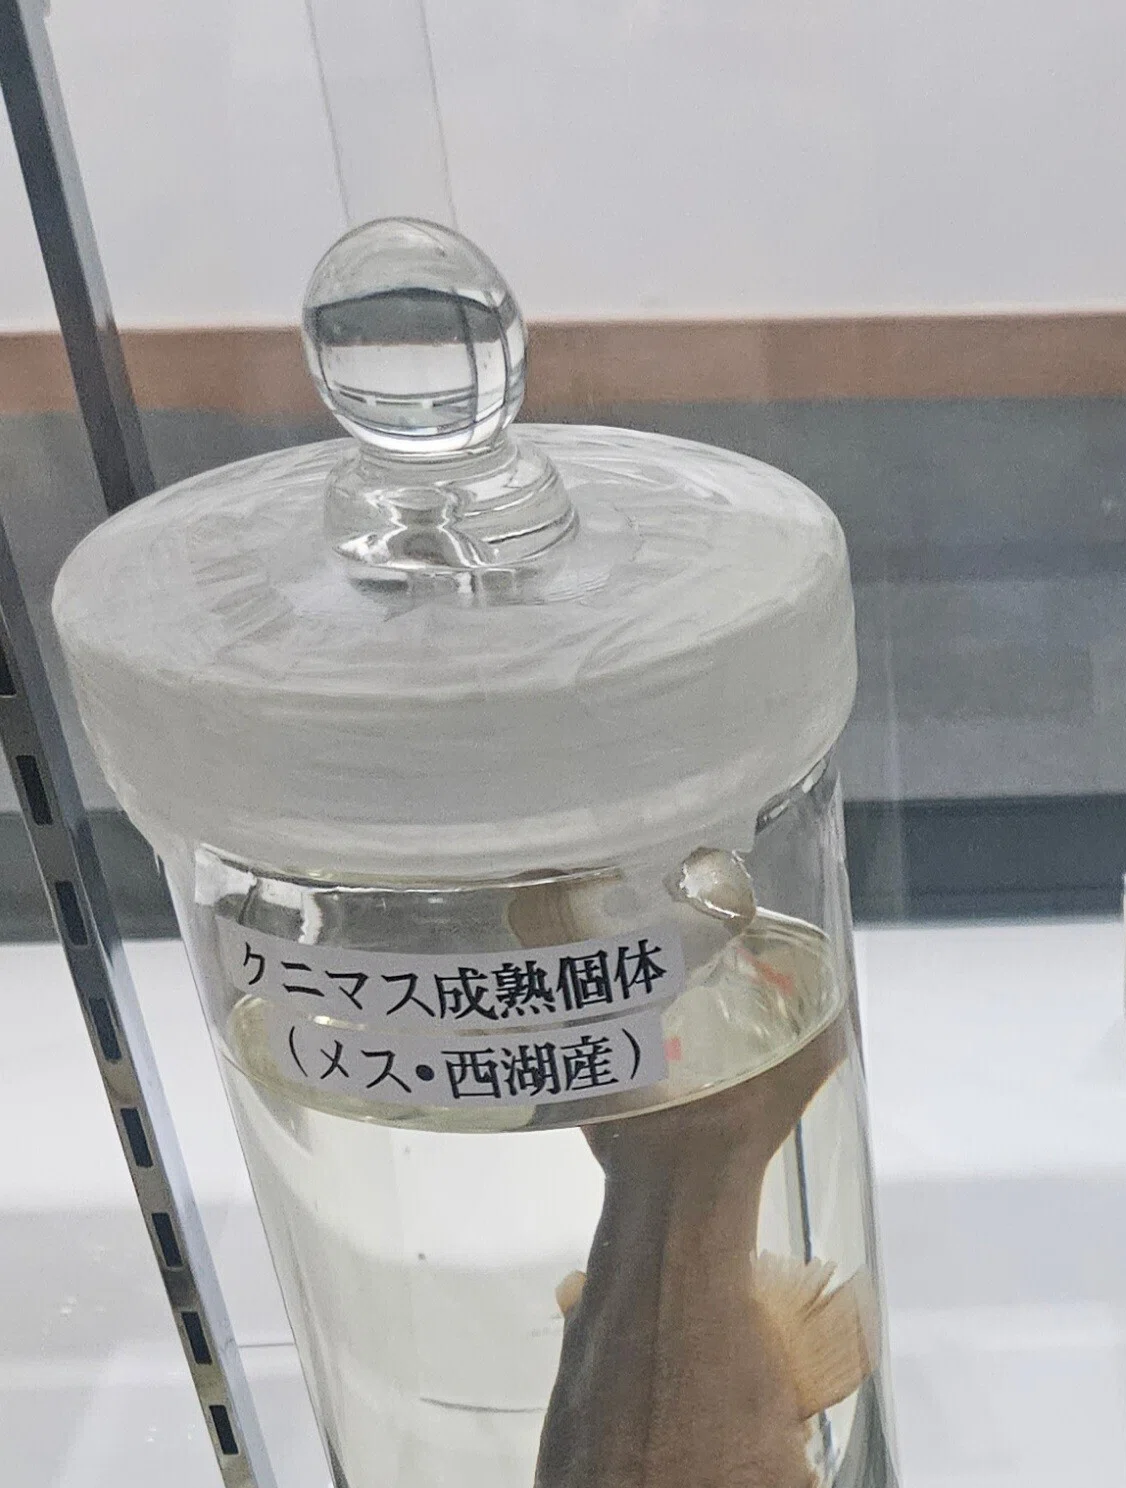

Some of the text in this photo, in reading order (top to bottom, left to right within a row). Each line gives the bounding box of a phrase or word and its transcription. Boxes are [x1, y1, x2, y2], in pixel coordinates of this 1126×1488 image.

[243, 938, 667, 1021] クニマス成熟個体
